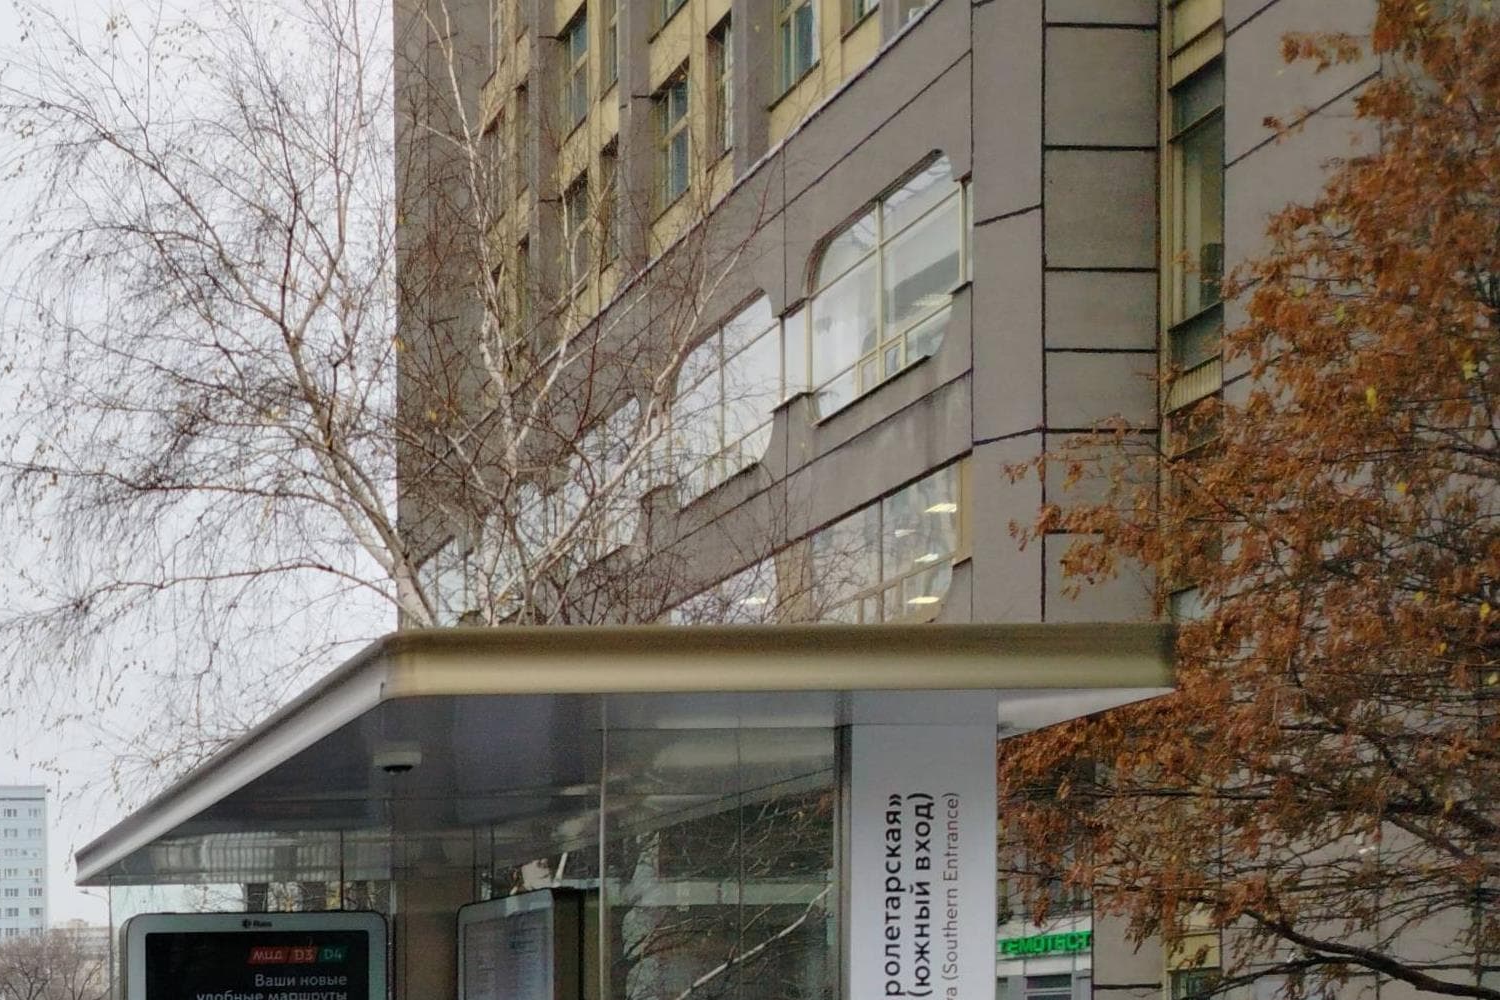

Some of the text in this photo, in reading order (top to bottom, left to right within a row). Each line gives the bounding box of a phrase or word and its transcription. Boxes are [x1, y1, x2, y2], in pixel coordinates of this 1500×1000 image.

[942, 793, 960, 881] Entrance)
[907, 793, 934, 997] (южный вход)
[942, 888, 958, 980] (Southern
[254, 973, 348, 987] Ваши новые
